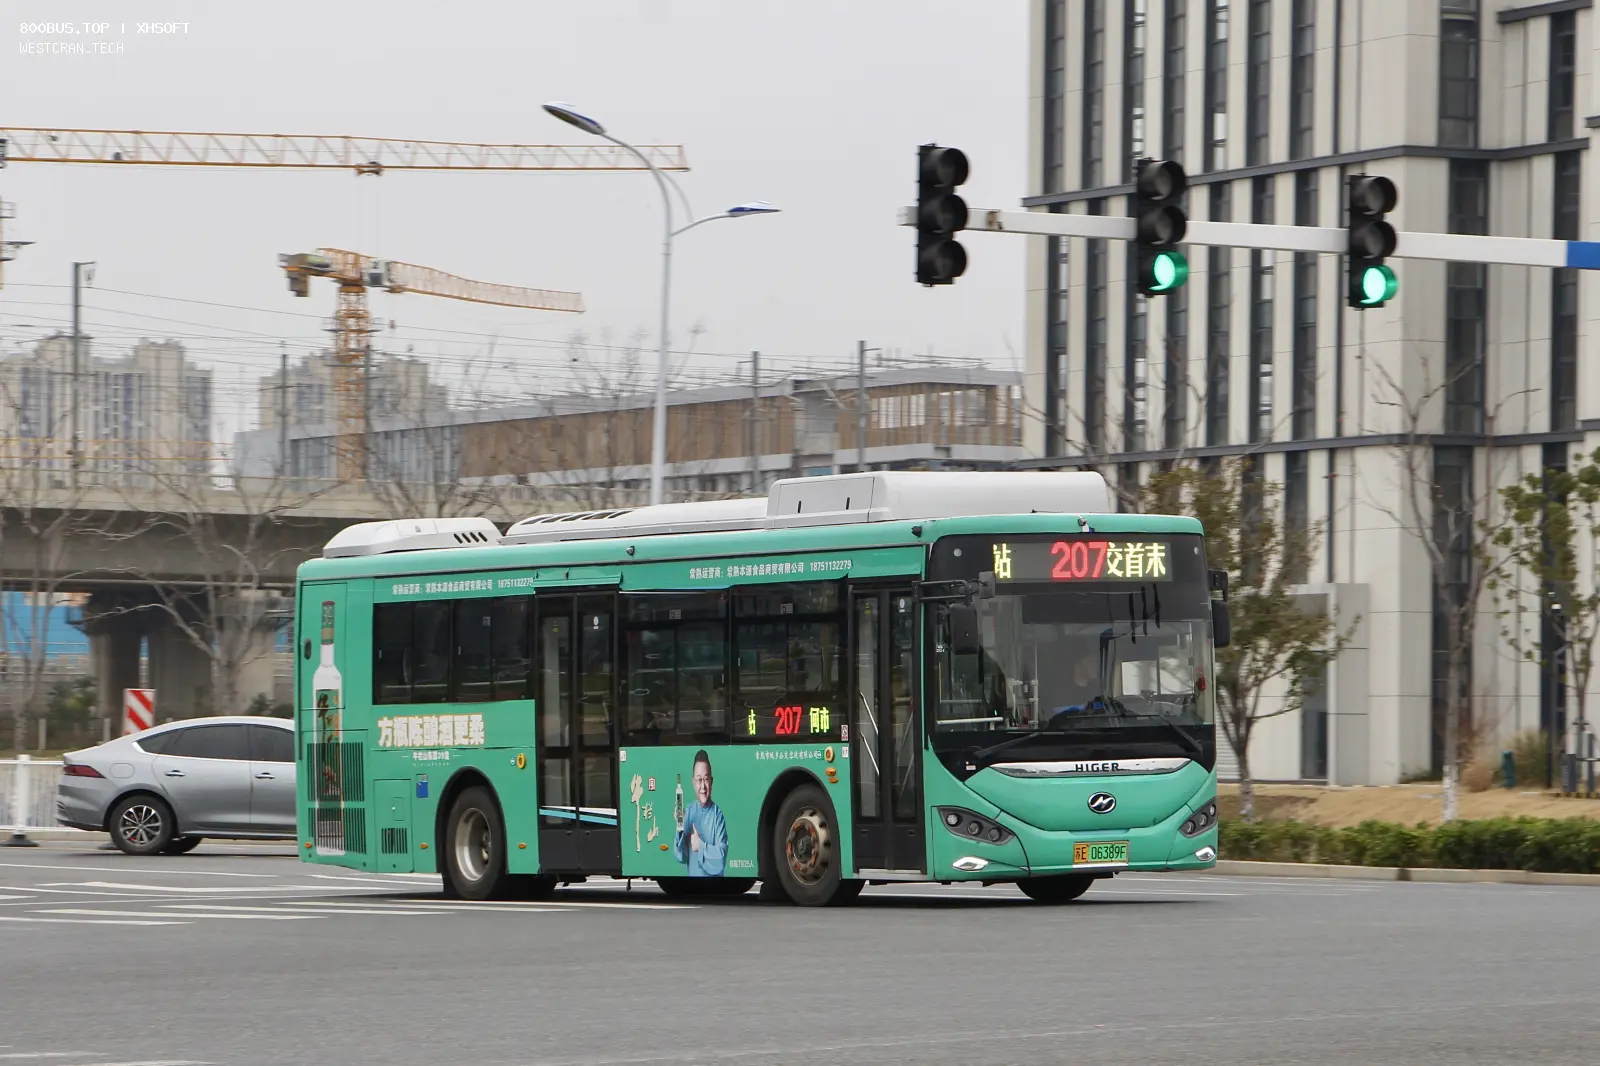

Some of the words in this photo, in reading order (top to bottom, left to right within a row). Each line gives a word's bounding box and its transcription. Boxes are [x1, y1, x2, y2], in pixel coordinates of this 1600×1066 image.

[810, 559, 852, 572] 18751132279
[1051, 541, 1109, 579] 207
[1107, 542, 1167, 578] 交首末
[774, 706, 803, 735] 207
[1075, 762, 1120, 773] HIGER
